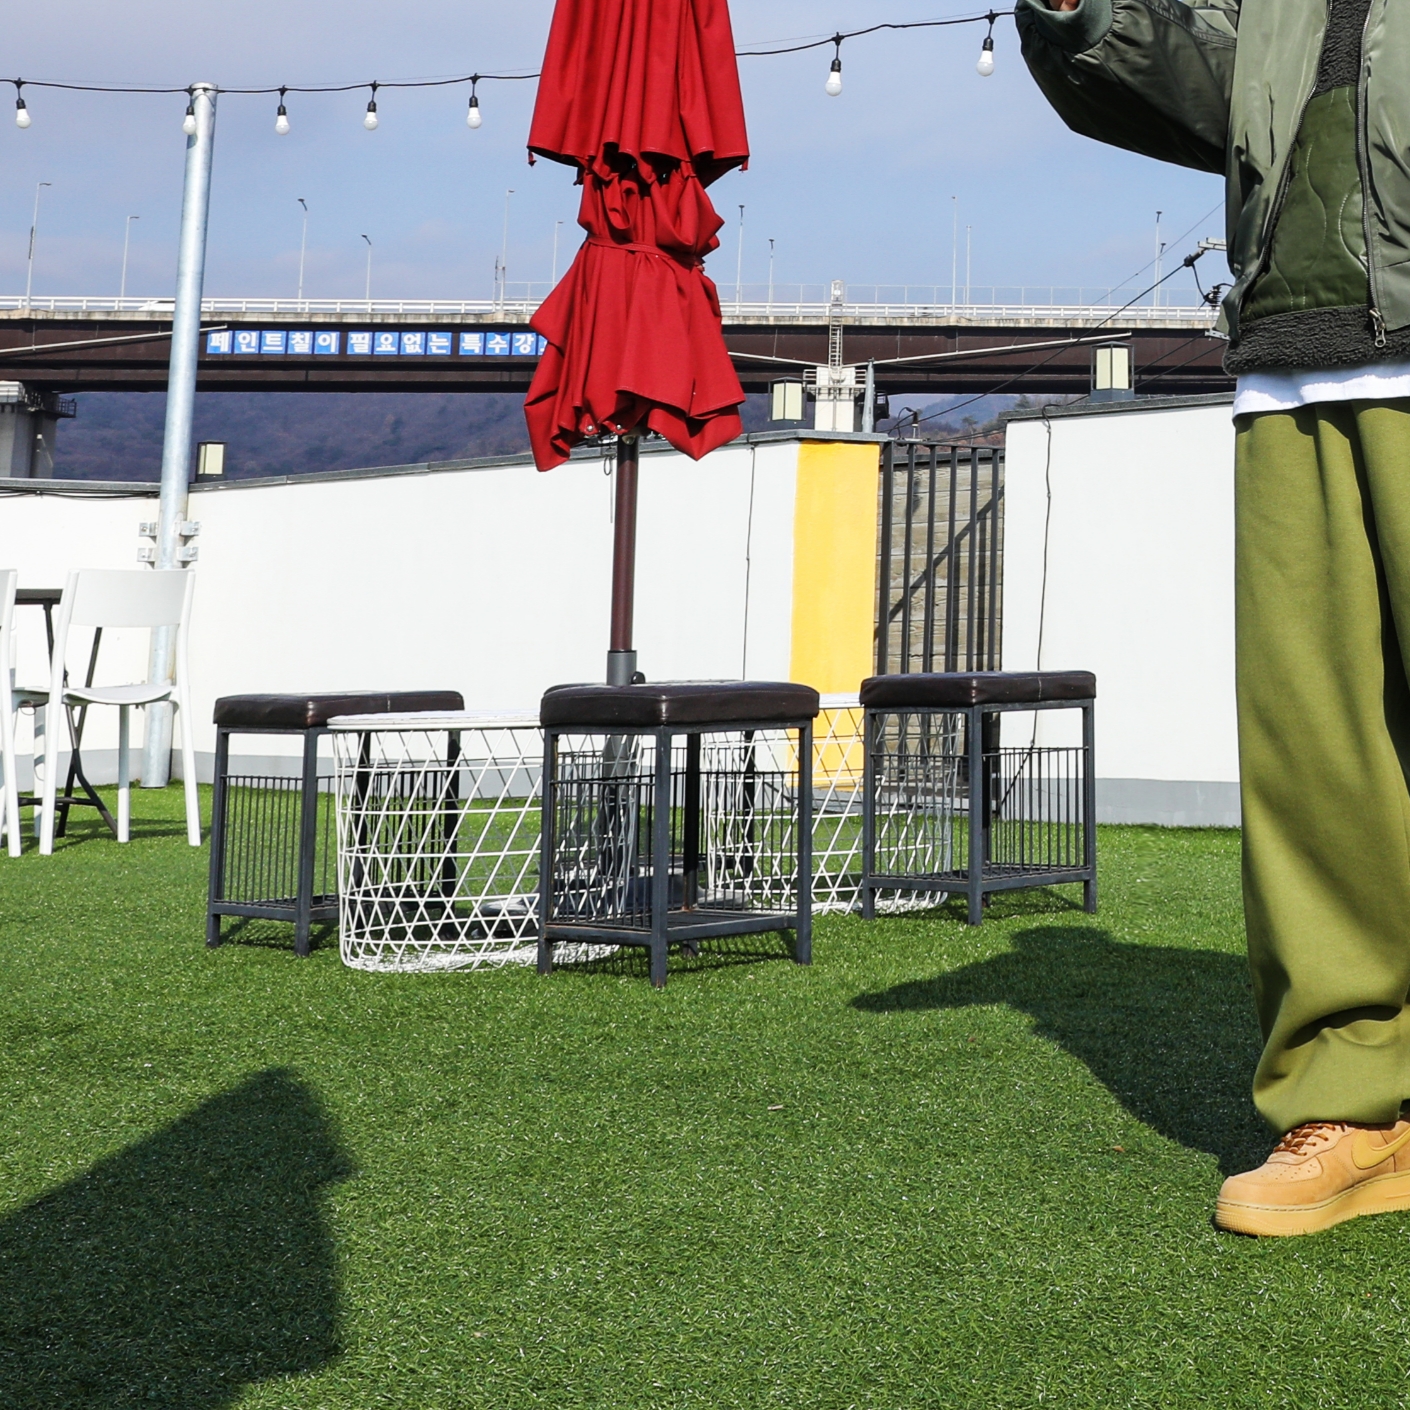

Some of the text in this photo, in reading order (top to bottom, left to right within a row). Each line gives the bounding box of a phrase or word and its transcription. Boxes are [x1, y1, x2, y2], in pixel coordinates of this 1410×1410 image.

[210, 331, 548, 354] 페인트칠이 필요없는 특수강
